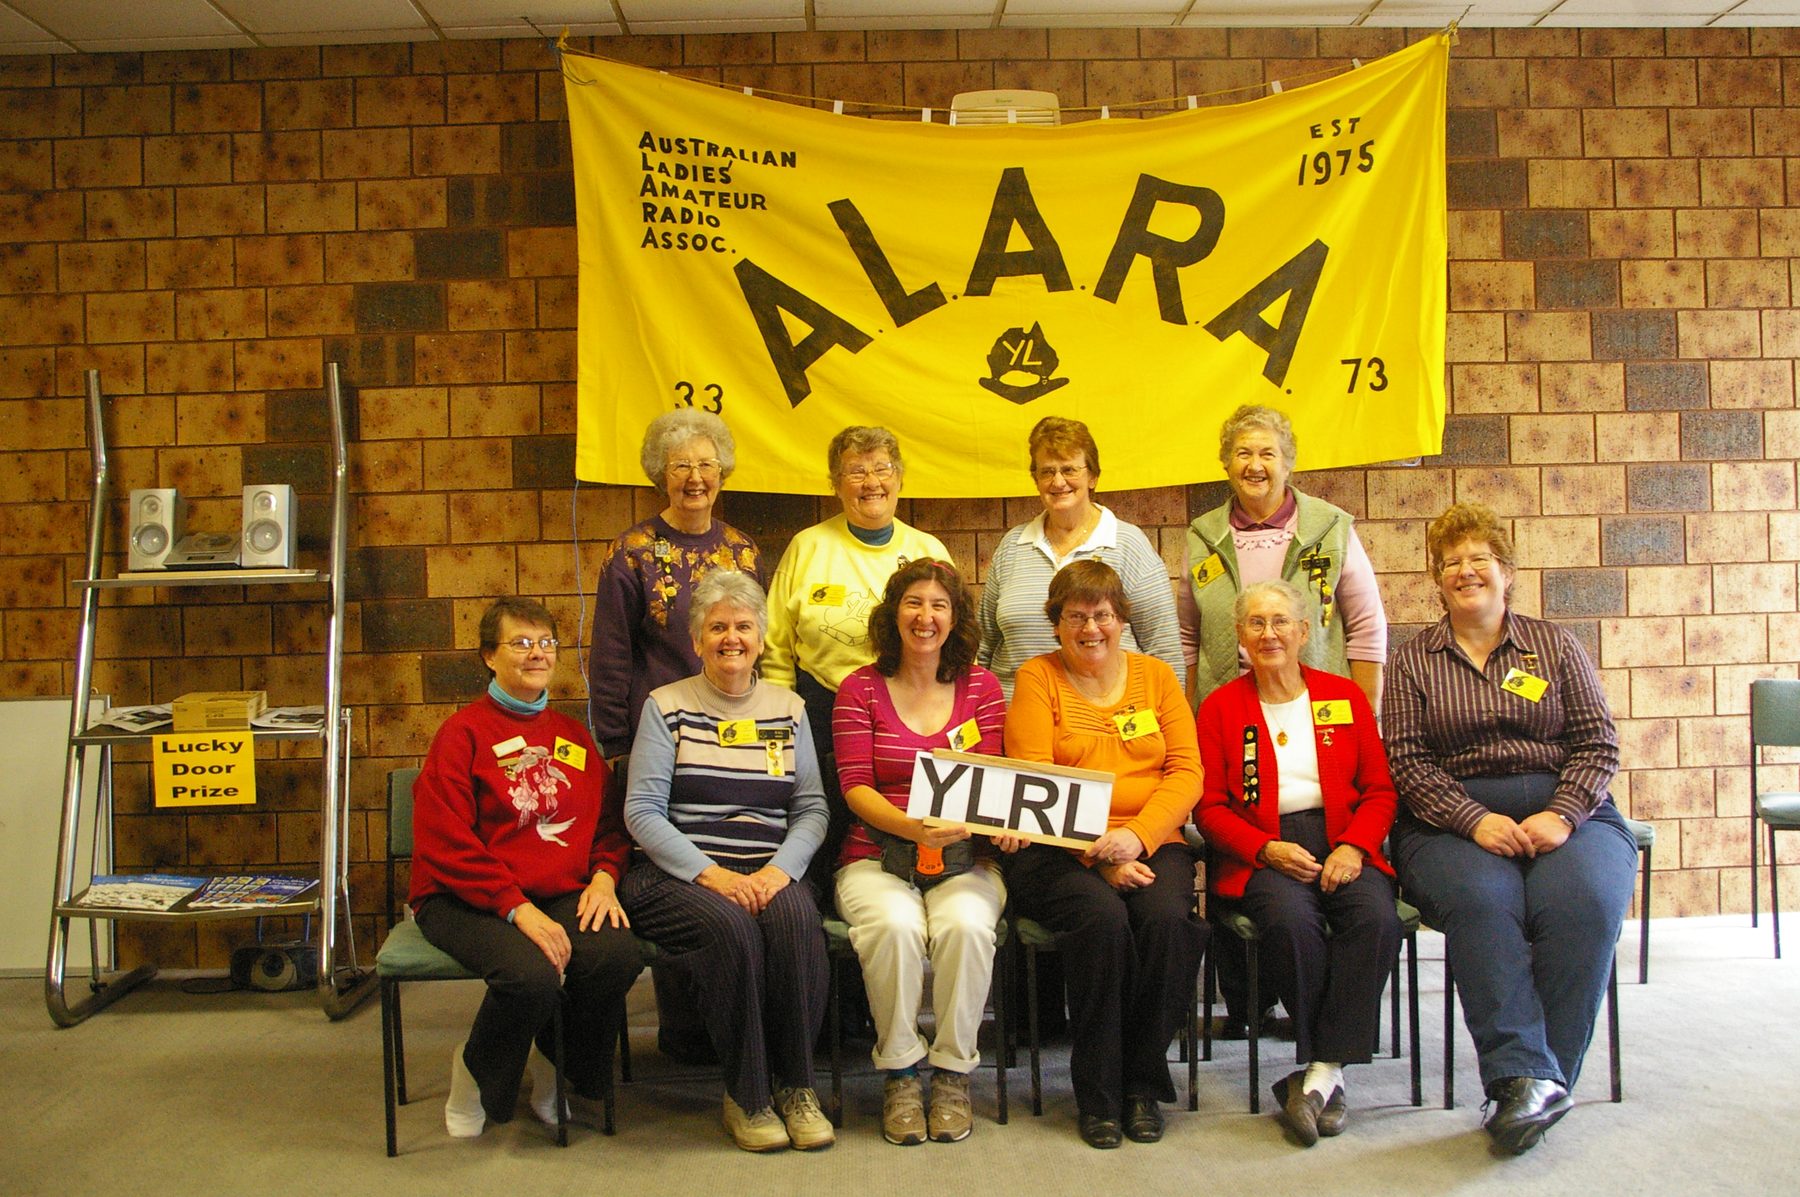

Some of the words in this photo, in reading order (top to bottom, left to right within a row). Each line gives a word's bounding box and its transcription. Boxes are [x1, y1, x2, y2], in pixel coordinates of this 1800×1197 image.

[1310, 117, 1361, 139] EST
[638, 131, 797, 168] AUSTRALIAN
[1298, 139, 1375, 186] 1975
[639, 174, 768, 211] AMATEUR
[642, 202, 721, 229] RADIO
[641, 226, 736, 254] ASSOC.
[1002, 339, 1042, 366] YL
[1340, 357, 1389, 394] 73
[674, 381, 723, 415] 33
[162, 739, 244, 754] Lucky
[172, 763, 236, 776] Door
[172, 785, 239, 798] Prize
[920, 756, 1103, 842] YLRL
